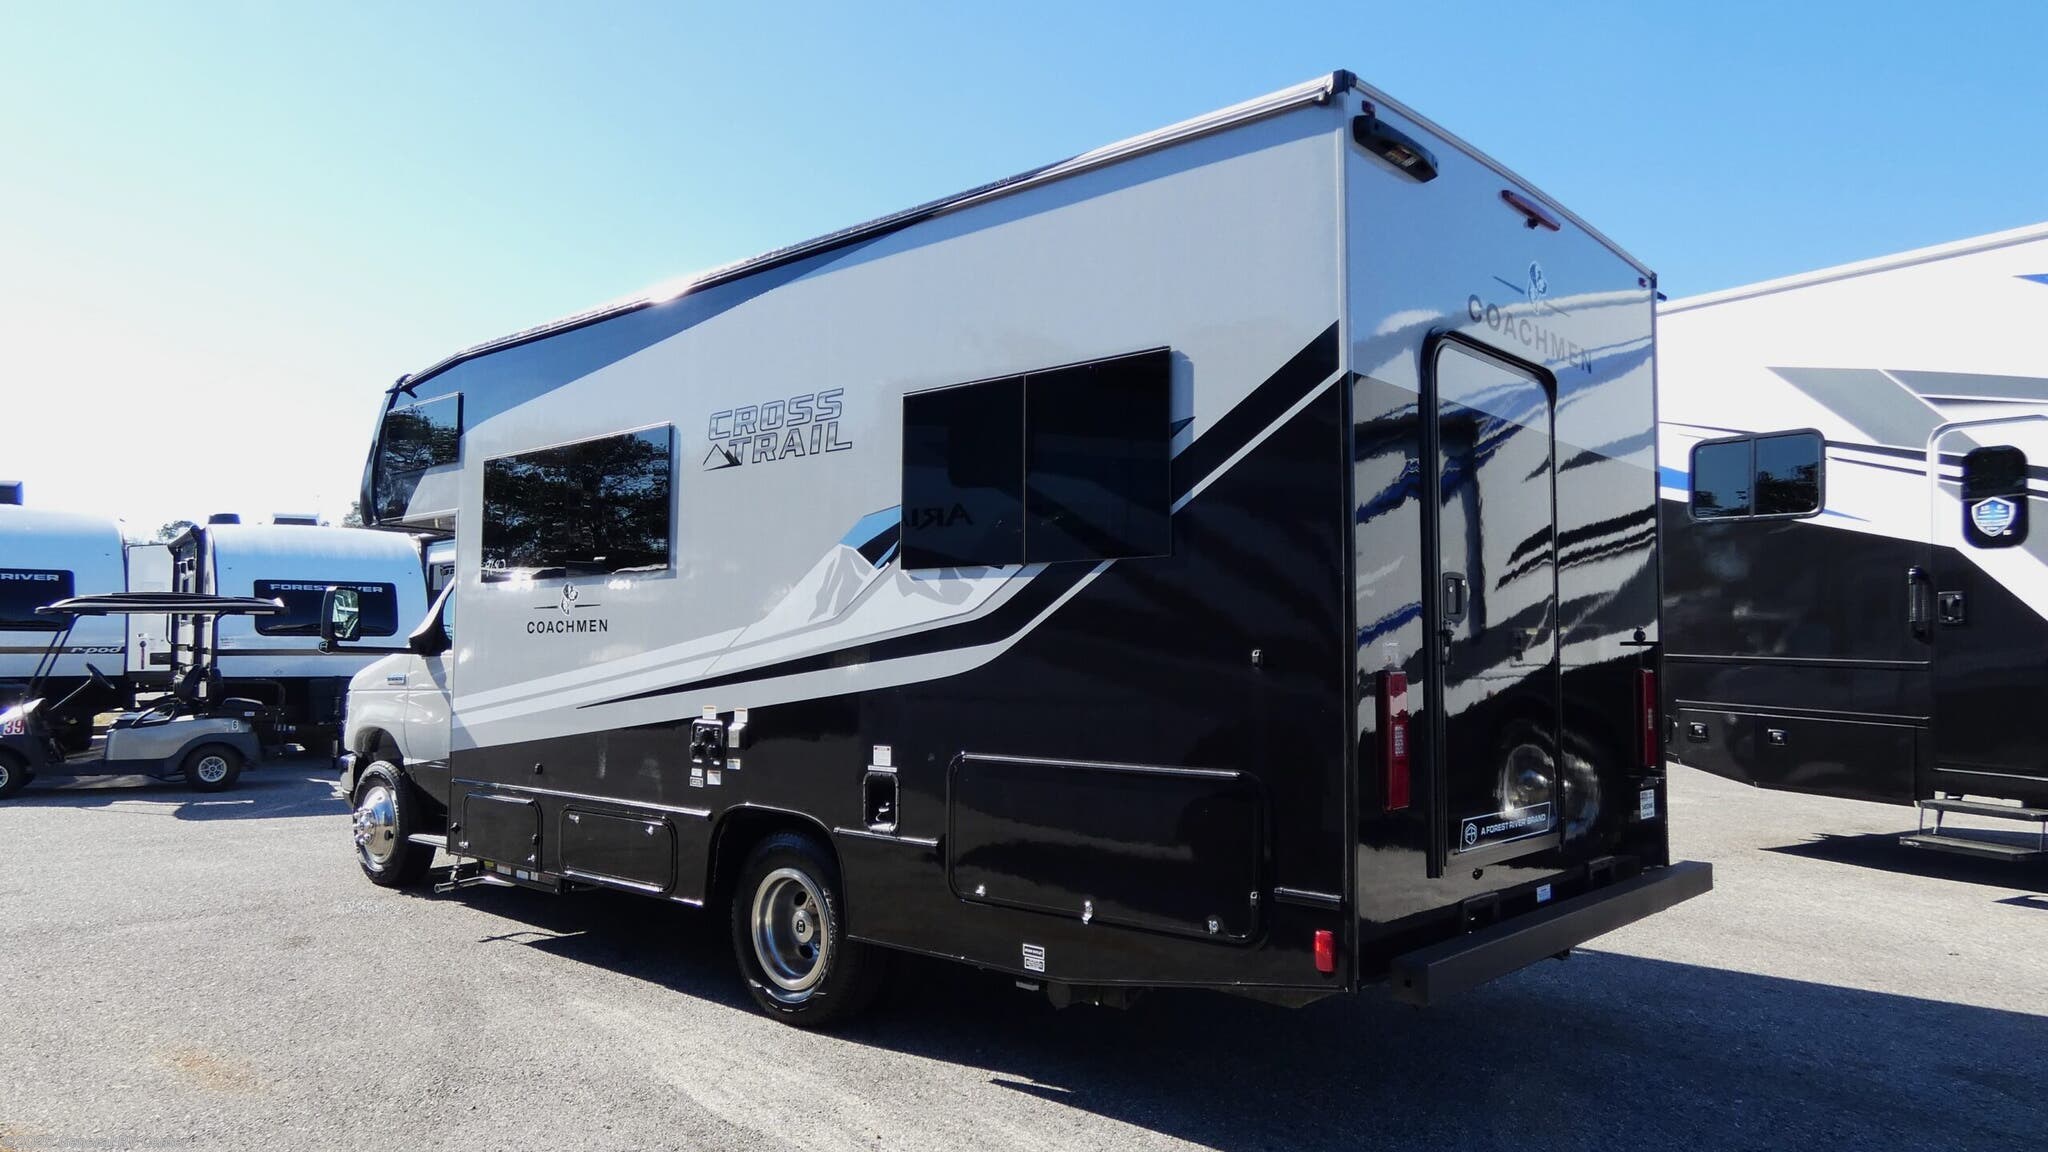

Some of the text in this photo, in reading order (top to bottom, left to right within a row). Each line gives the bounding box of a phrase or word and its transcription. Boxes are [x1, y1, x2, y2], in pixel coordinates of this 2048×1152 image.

[1468, 294, 1592, 374] COACHMEN
[708, 387, 844, 441] CROSS
[728, 421, 853, 466] TRAIL
[0, 573, 60, 581] RIVER
[526, 619, 608, 634] COACHMEN
[4, 720, 24, 734] 39
[1481, 814, 1546, 835] A FOREST RIVER BRAND
